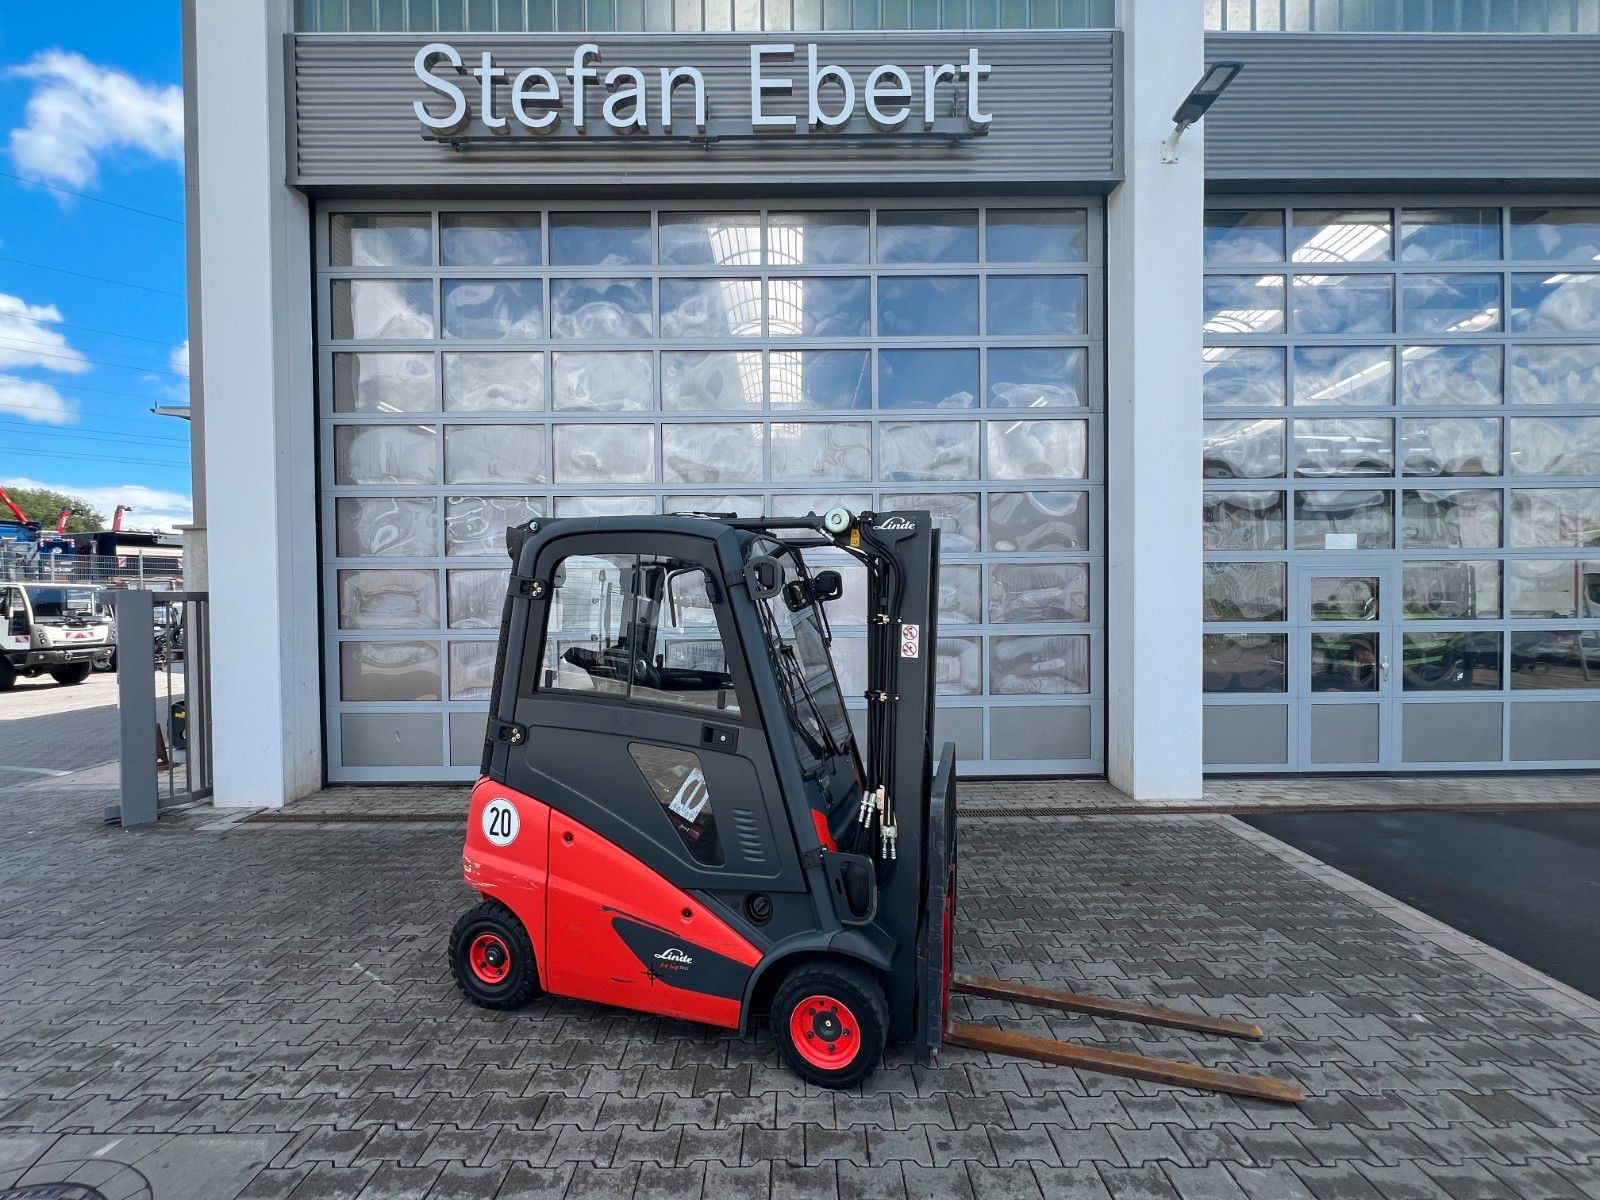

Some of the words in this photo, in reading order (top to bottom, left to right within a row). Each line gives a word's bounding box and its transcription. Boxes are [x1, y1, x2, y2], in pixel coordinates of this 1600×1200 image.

[413, 43, 706, 128] Stefan
[750, 43, 992, 127] Ebert
[872, 516, 916, 530] Linde
[489, 806, 512, 838] 20
[654, 948, 693, 964] Linde
